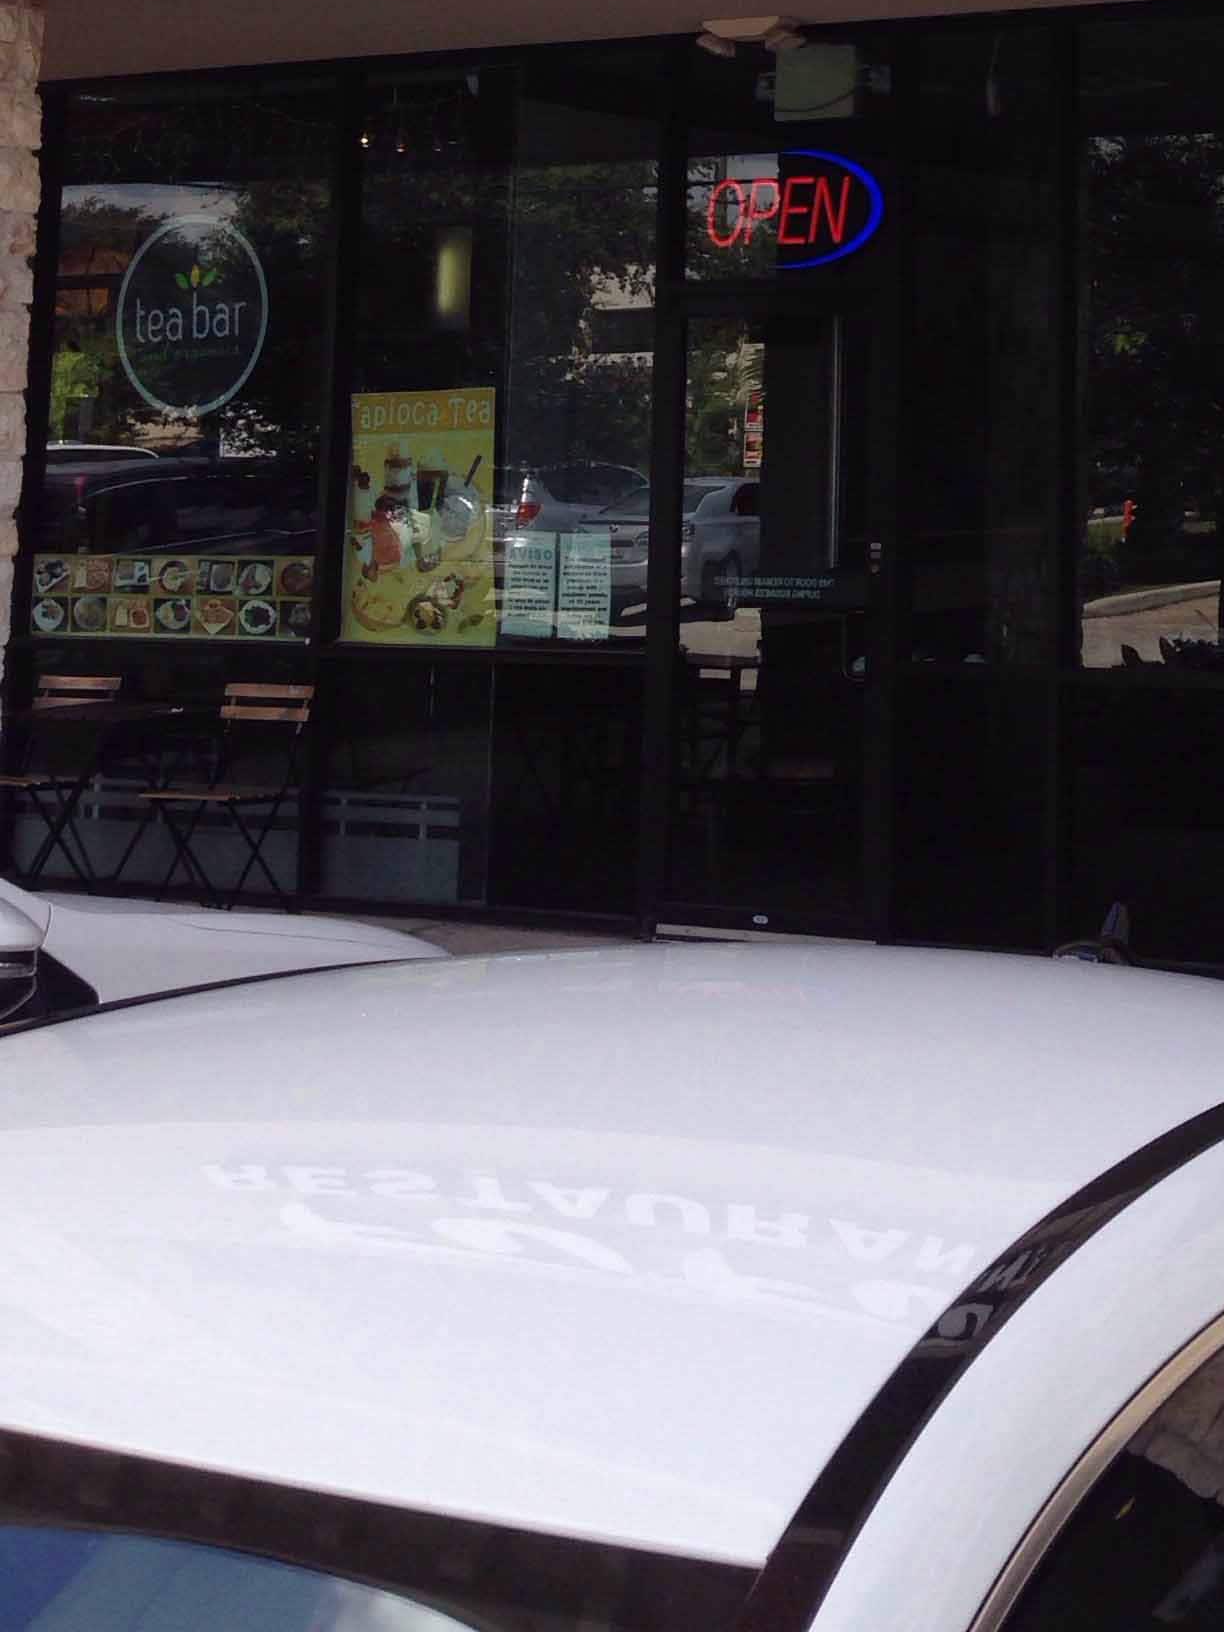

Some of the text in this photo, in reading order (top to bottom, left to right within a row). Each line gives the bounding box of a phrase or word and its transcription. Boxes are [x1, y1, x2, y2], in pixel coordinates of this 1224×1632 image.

[705, 175, 852, 248] OPEN
[135, 291, 248, 344] tea bar
